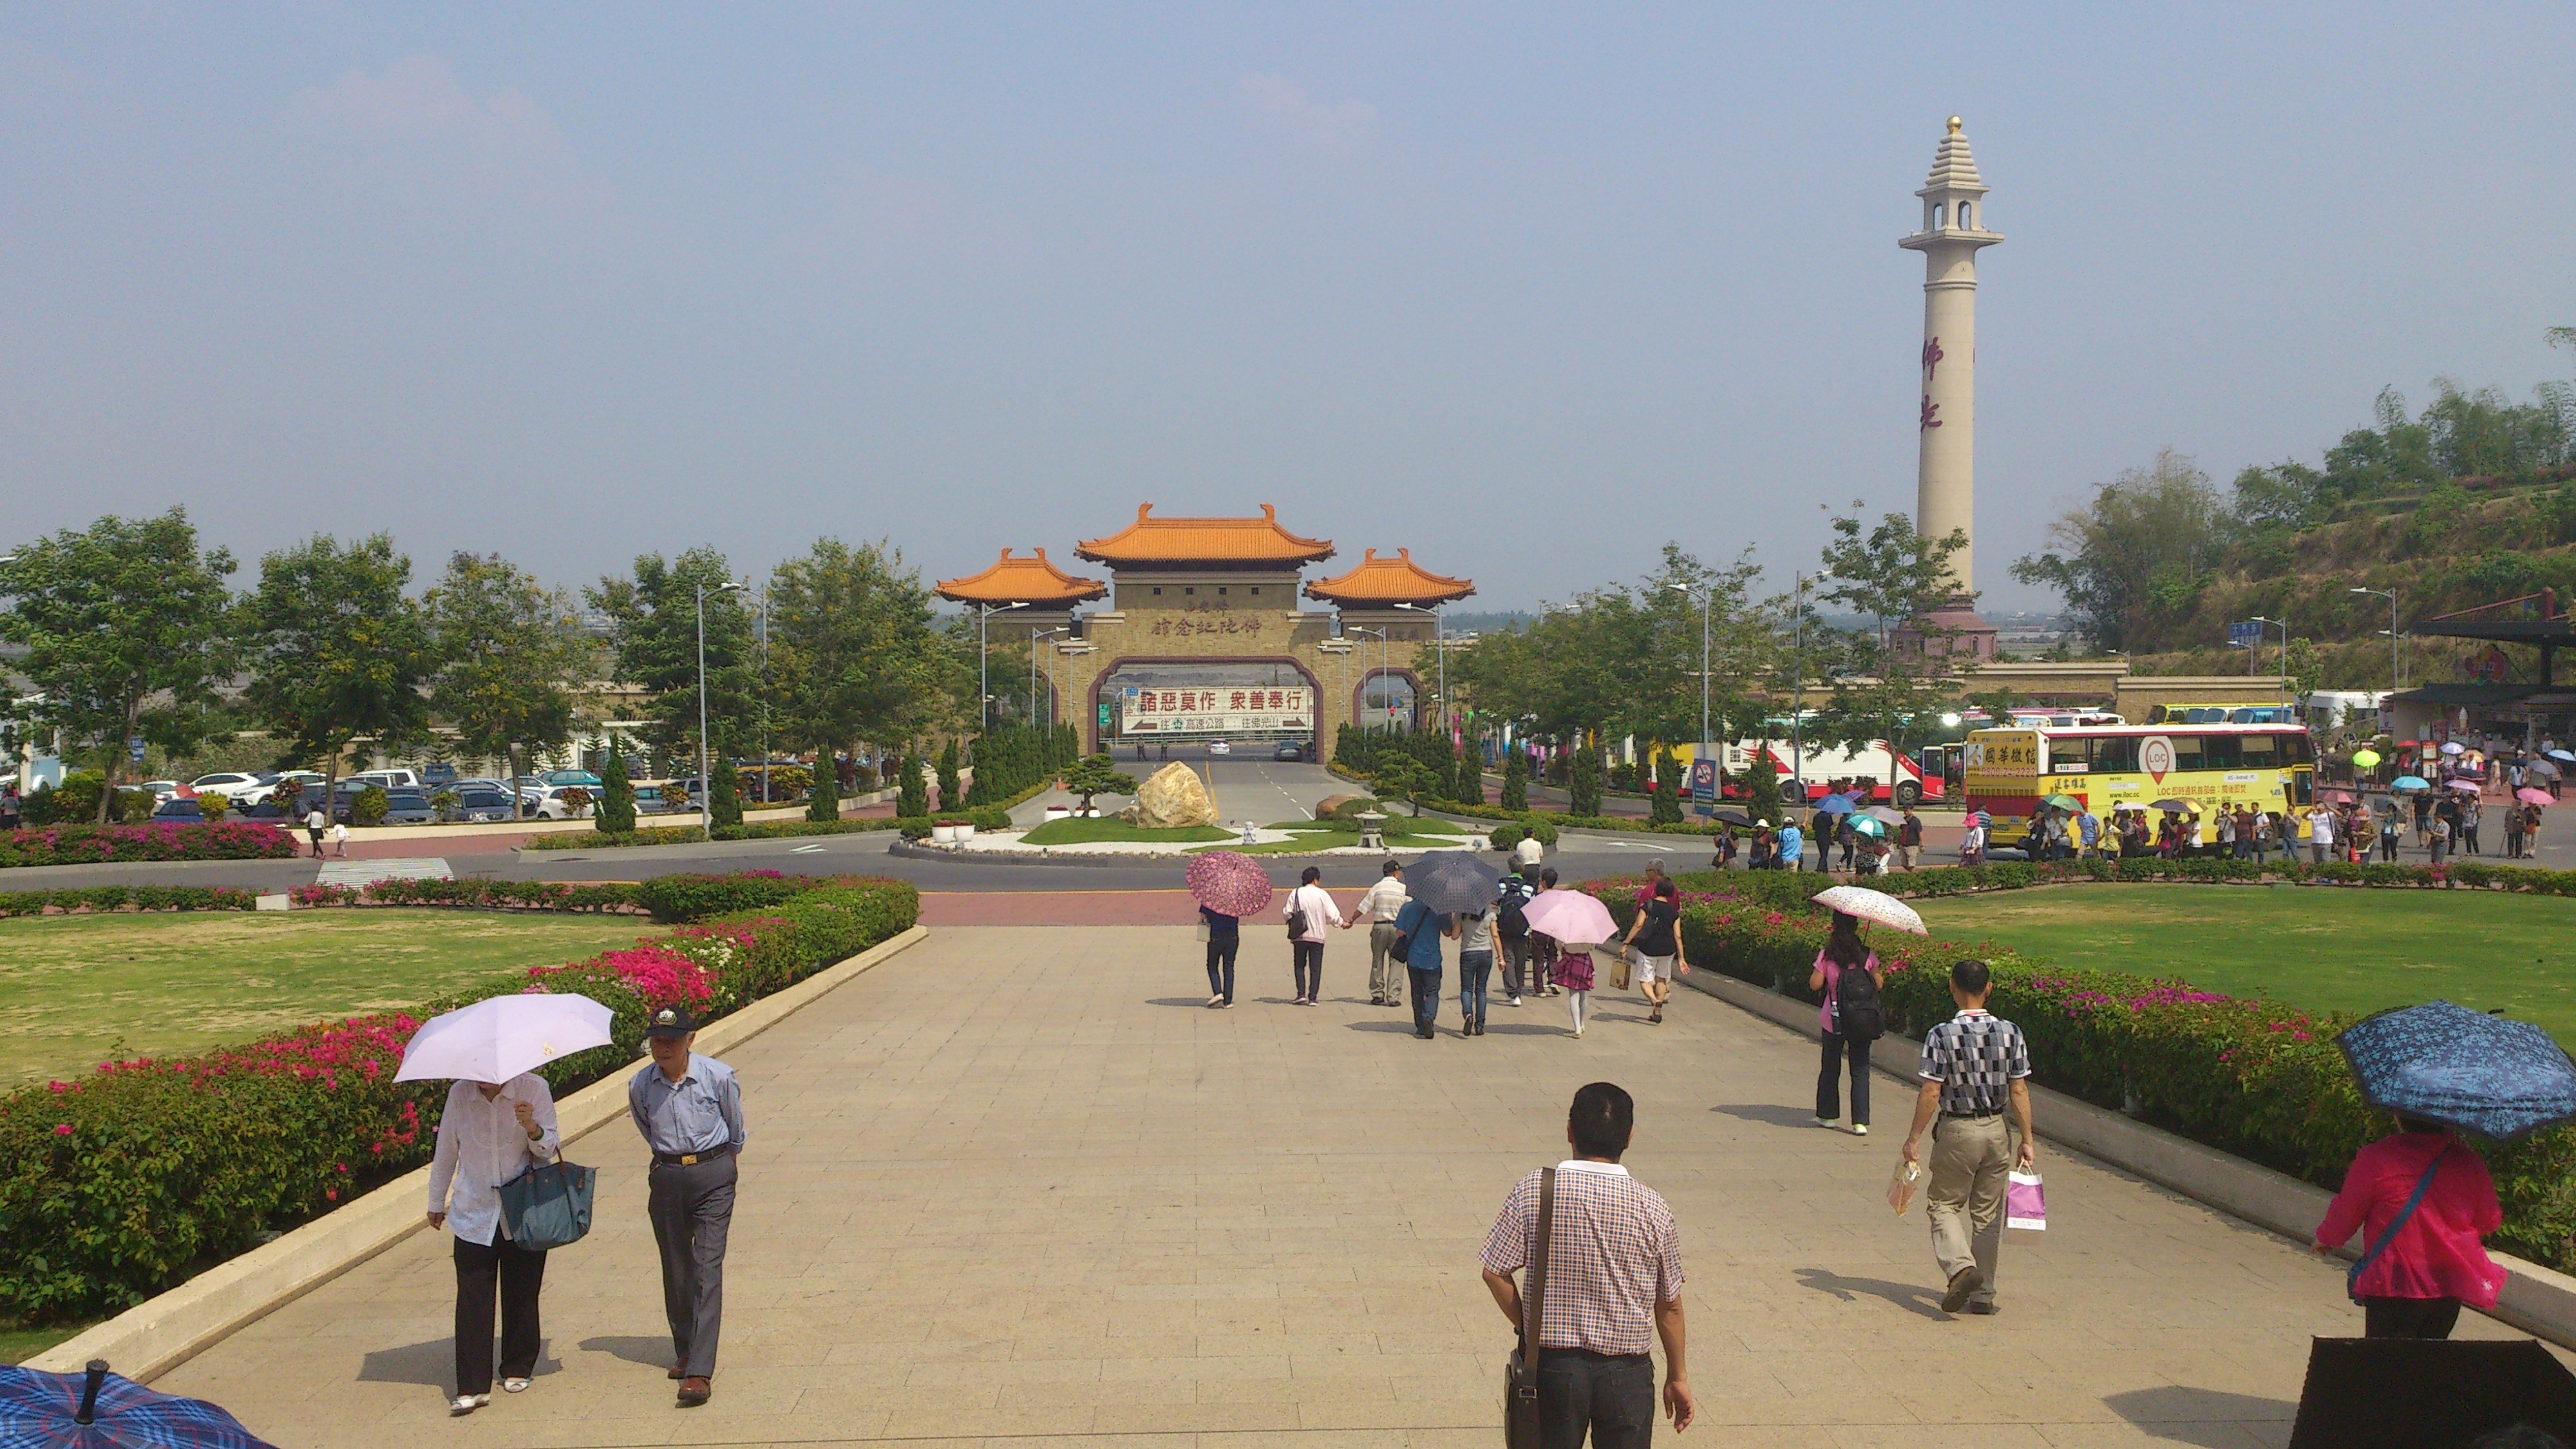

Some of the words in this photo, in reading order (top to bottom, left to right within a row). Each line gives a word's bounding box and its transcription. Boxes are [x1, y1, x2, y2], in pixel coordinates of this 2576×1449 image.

[1141, 691, 1216, 712] 諸惡莫作
[1160, 719, 1170, 730] 往
[1186, 718, 1224, 730] 高速公路
[1242, 717, 1278, 729] 往佛光山
[2149, 753, 2166, 763] LOC
[2157, 788, 2171, 796] LOC
